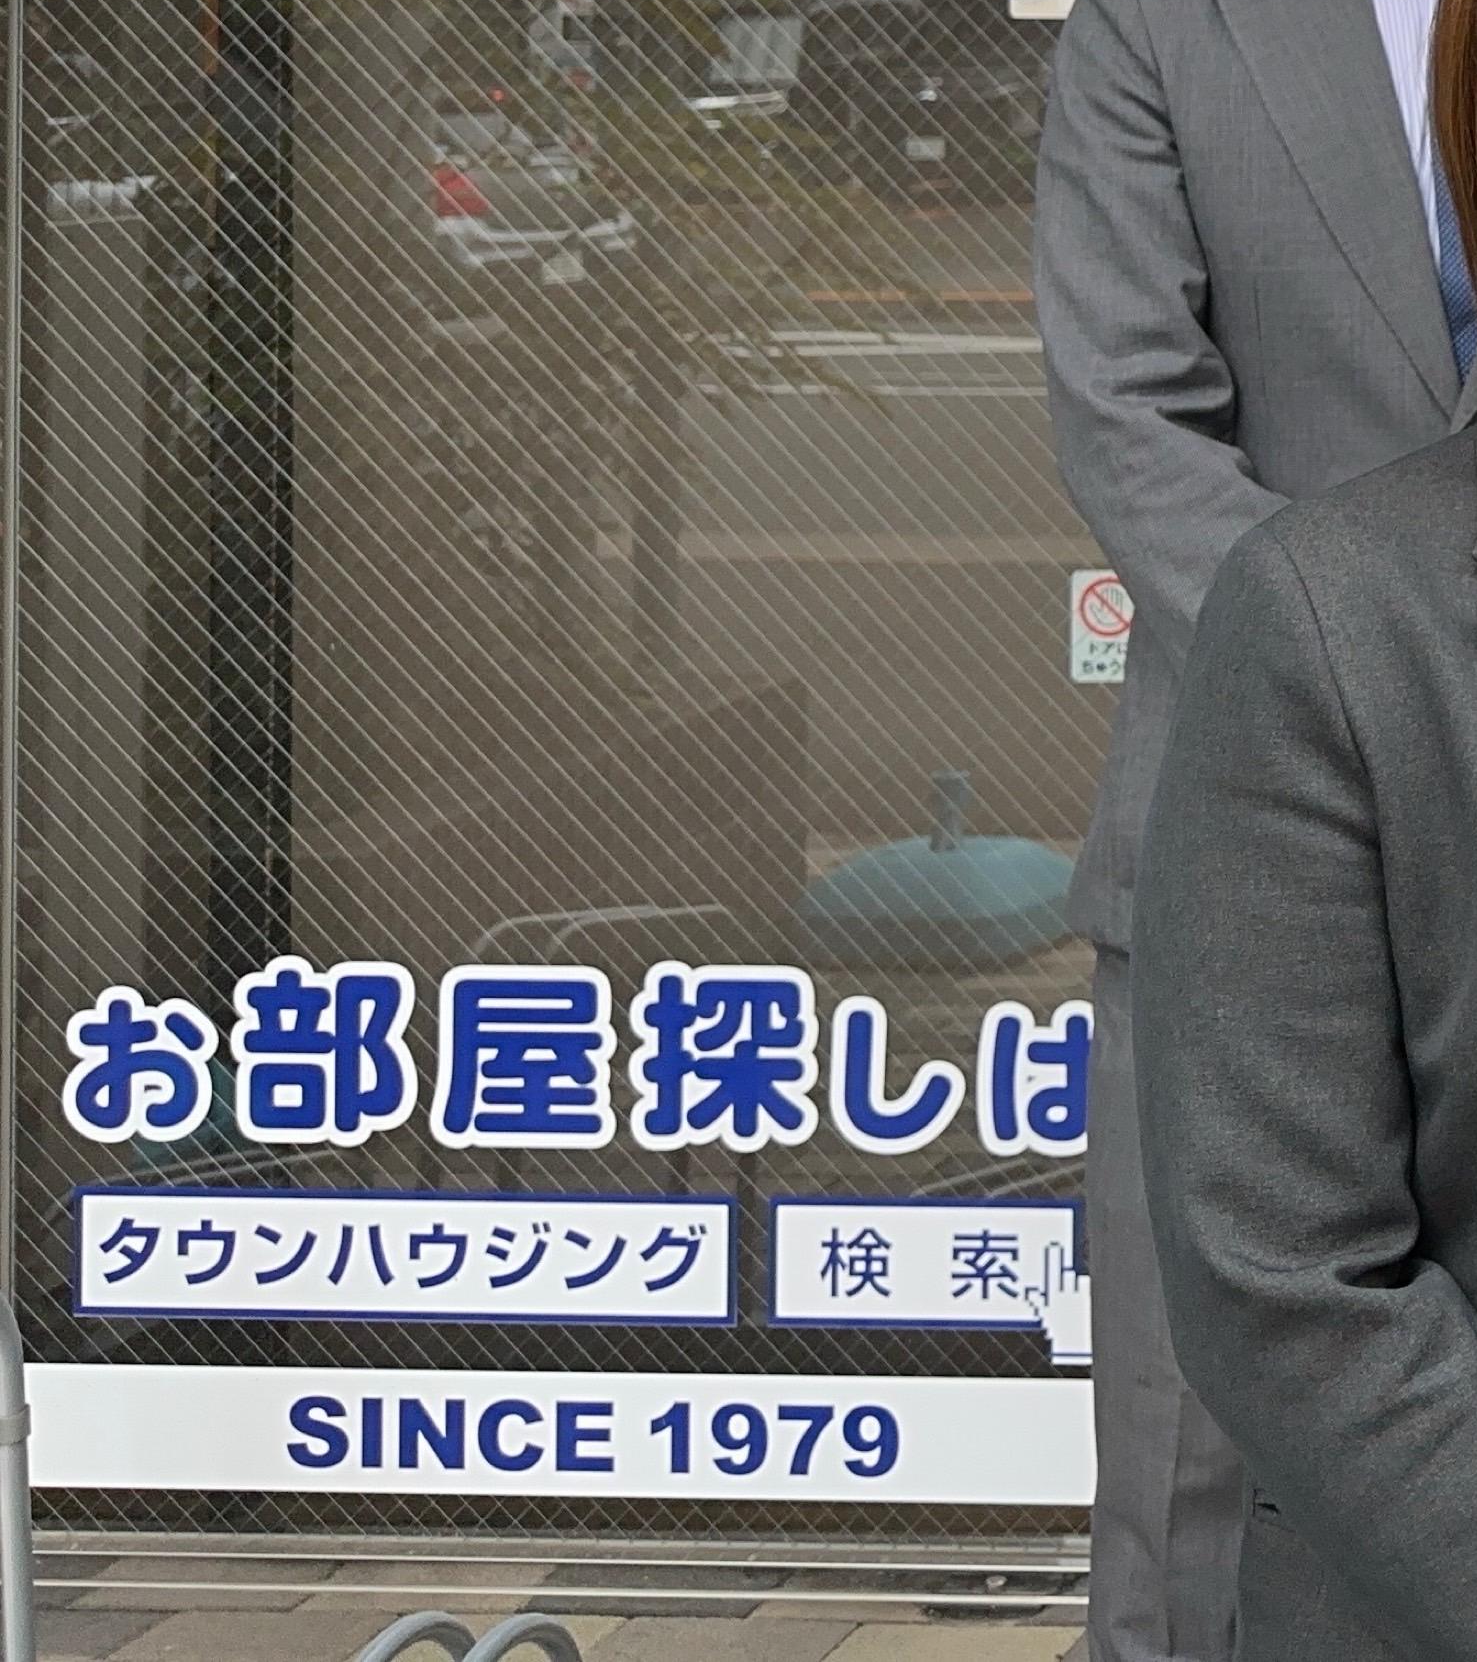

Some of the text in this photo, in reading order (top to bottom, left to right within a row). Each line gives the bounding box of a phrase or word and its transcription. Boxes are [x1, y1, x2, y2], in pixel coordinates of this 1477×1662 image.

[63, 955, 1094, 1155] お部屋探しは
[99, 1219, 708, 1293] タウンハウジング
[818, 1227, 1021, 1303] 検索
[285, 1395, 902, 1480] SINCE 1979
